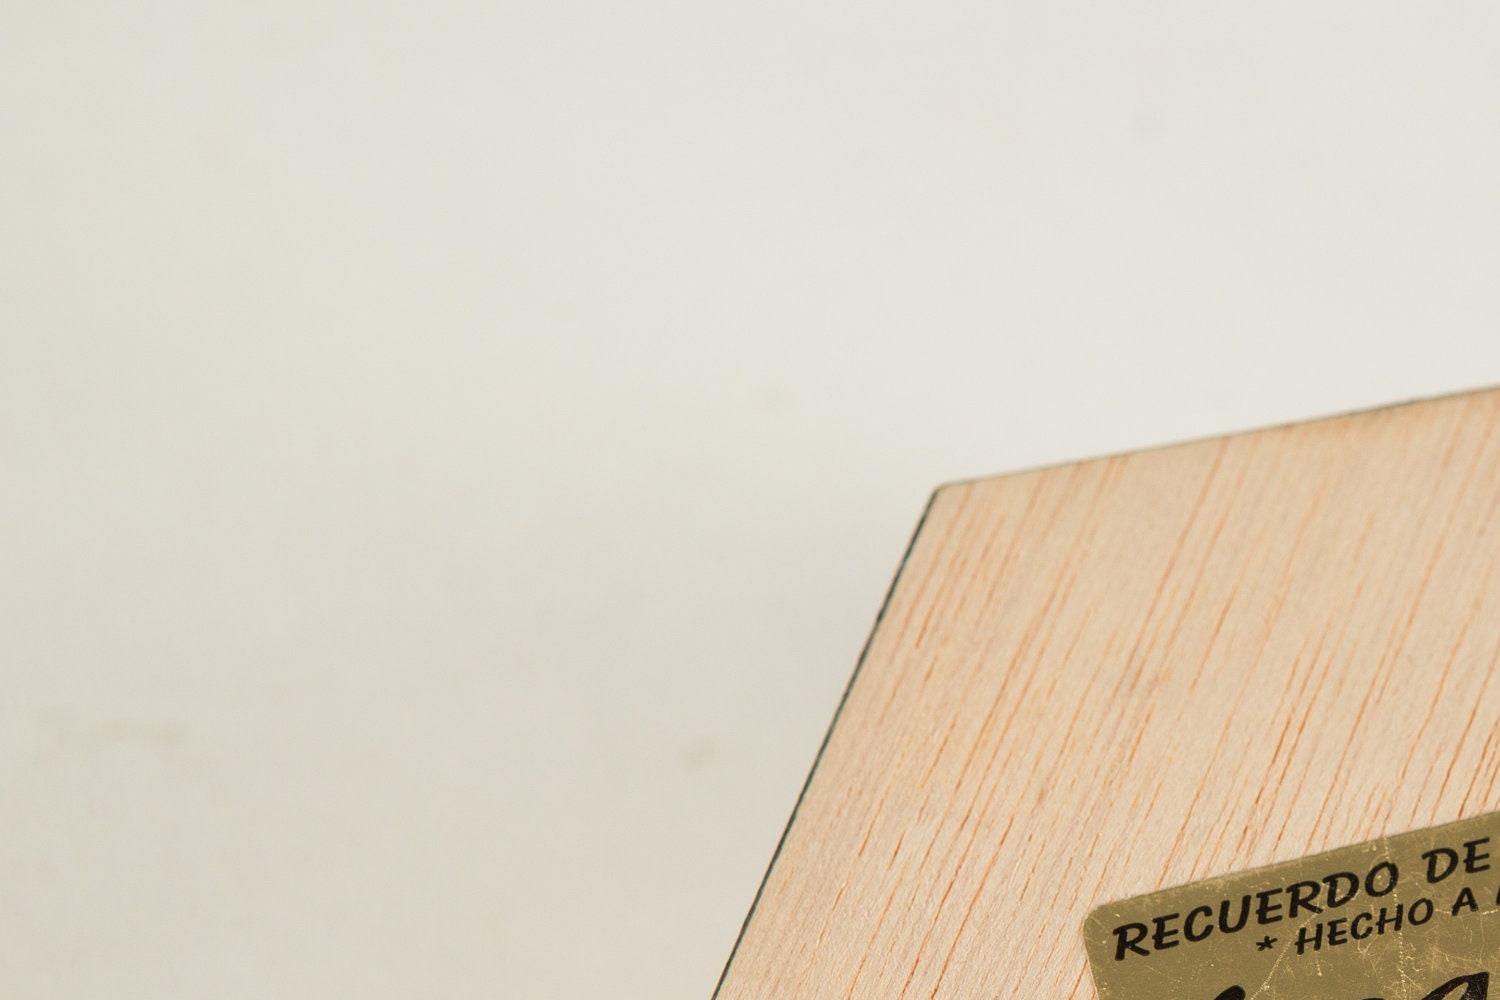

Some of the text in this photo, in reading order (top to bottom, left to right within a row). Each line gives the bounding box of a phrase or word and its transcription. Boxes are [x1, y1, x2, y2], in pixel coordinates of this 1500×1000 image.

[1112, 860, 1400, 962] RECUERDO
[1421, 836, 1491, 884] DE
[1294, 897, 1434, 956] HECHO
[1451, 886, 1479, 917] A
